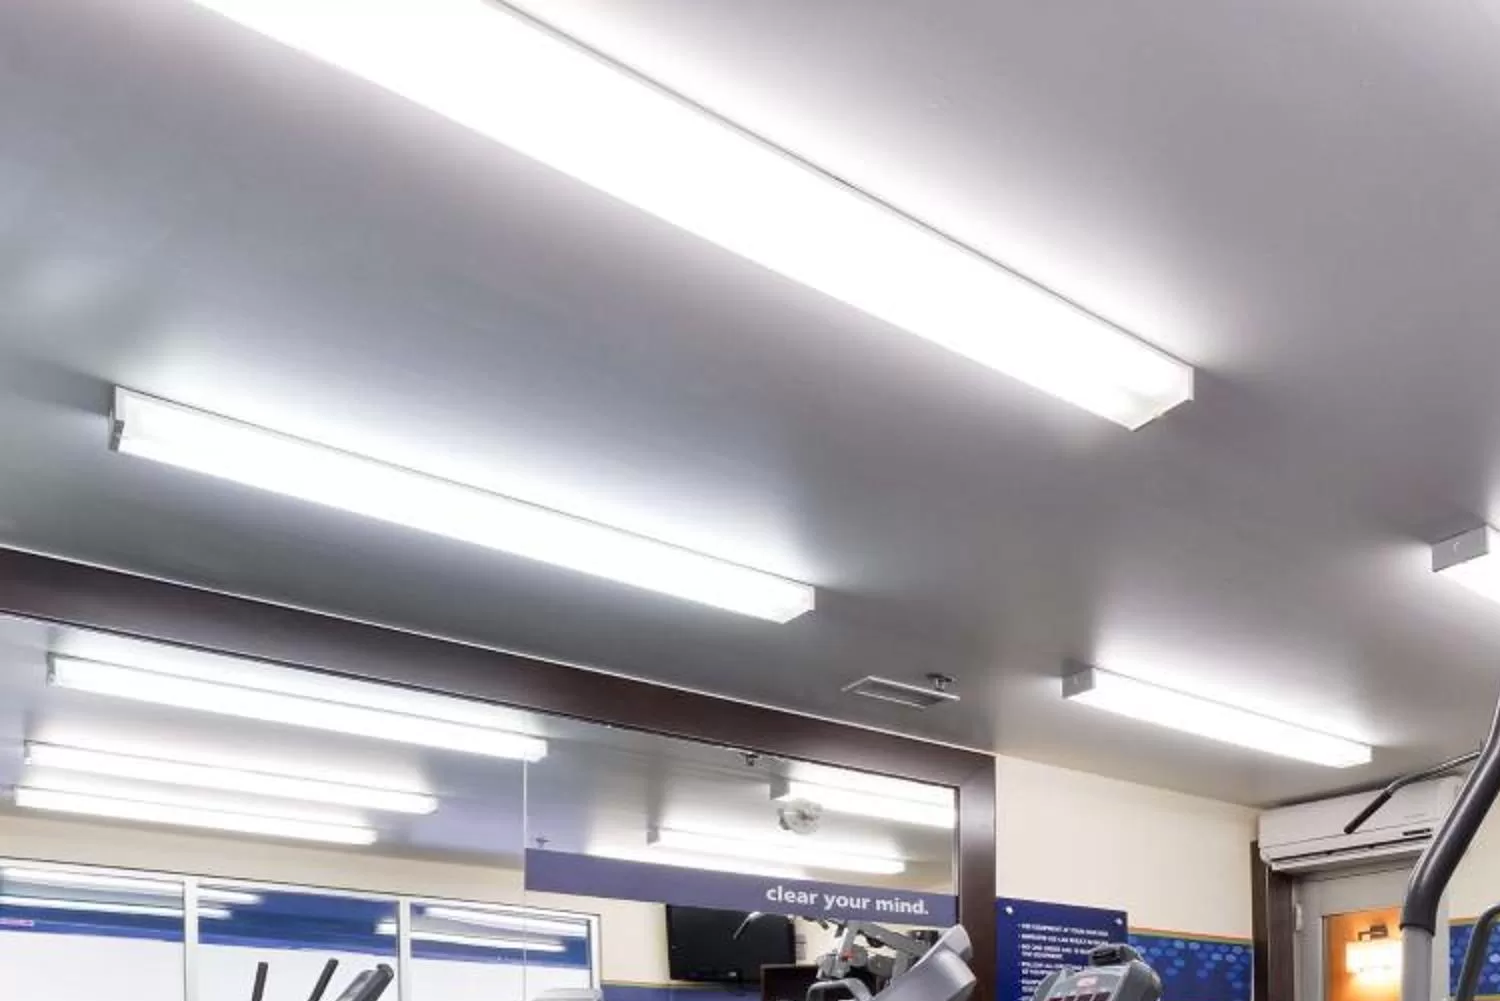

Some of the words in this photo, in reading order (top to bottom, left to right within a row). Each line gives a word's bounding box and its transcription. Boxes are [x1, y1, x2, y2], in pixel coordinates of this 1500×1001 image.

[766, 885, 818, 905] clear
[823, 894, 872, 911] your
[875, 898, 929, 915] mind.
